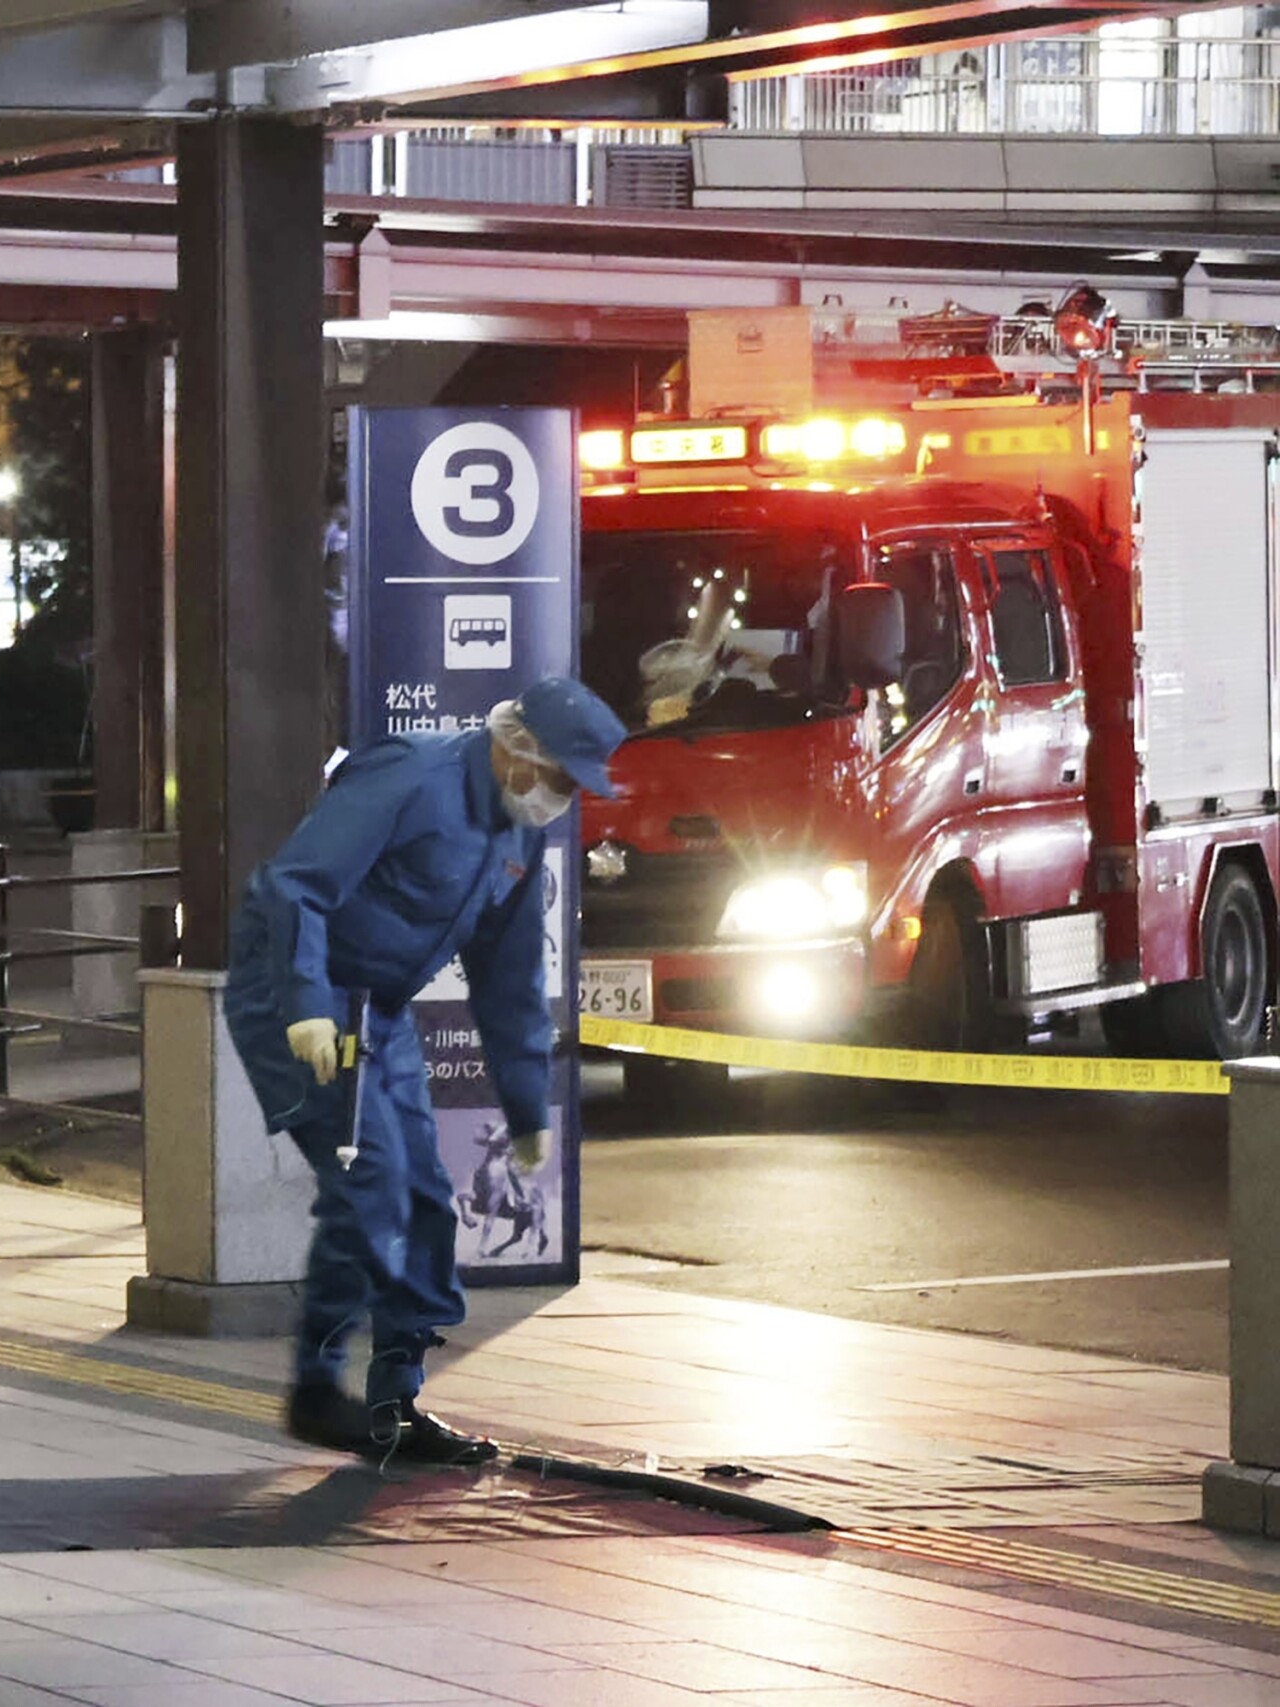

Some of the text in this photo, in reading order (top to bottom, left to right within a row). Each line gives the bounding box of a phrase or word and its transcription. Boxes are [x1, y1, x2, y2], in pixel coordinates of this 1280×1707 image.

[442, 448, 515, 538] 3
[385, 683, 437, 710] 松代
[387, 715, 492, 734] 川中島古
[578, 986, 641, 1012] 26-96
